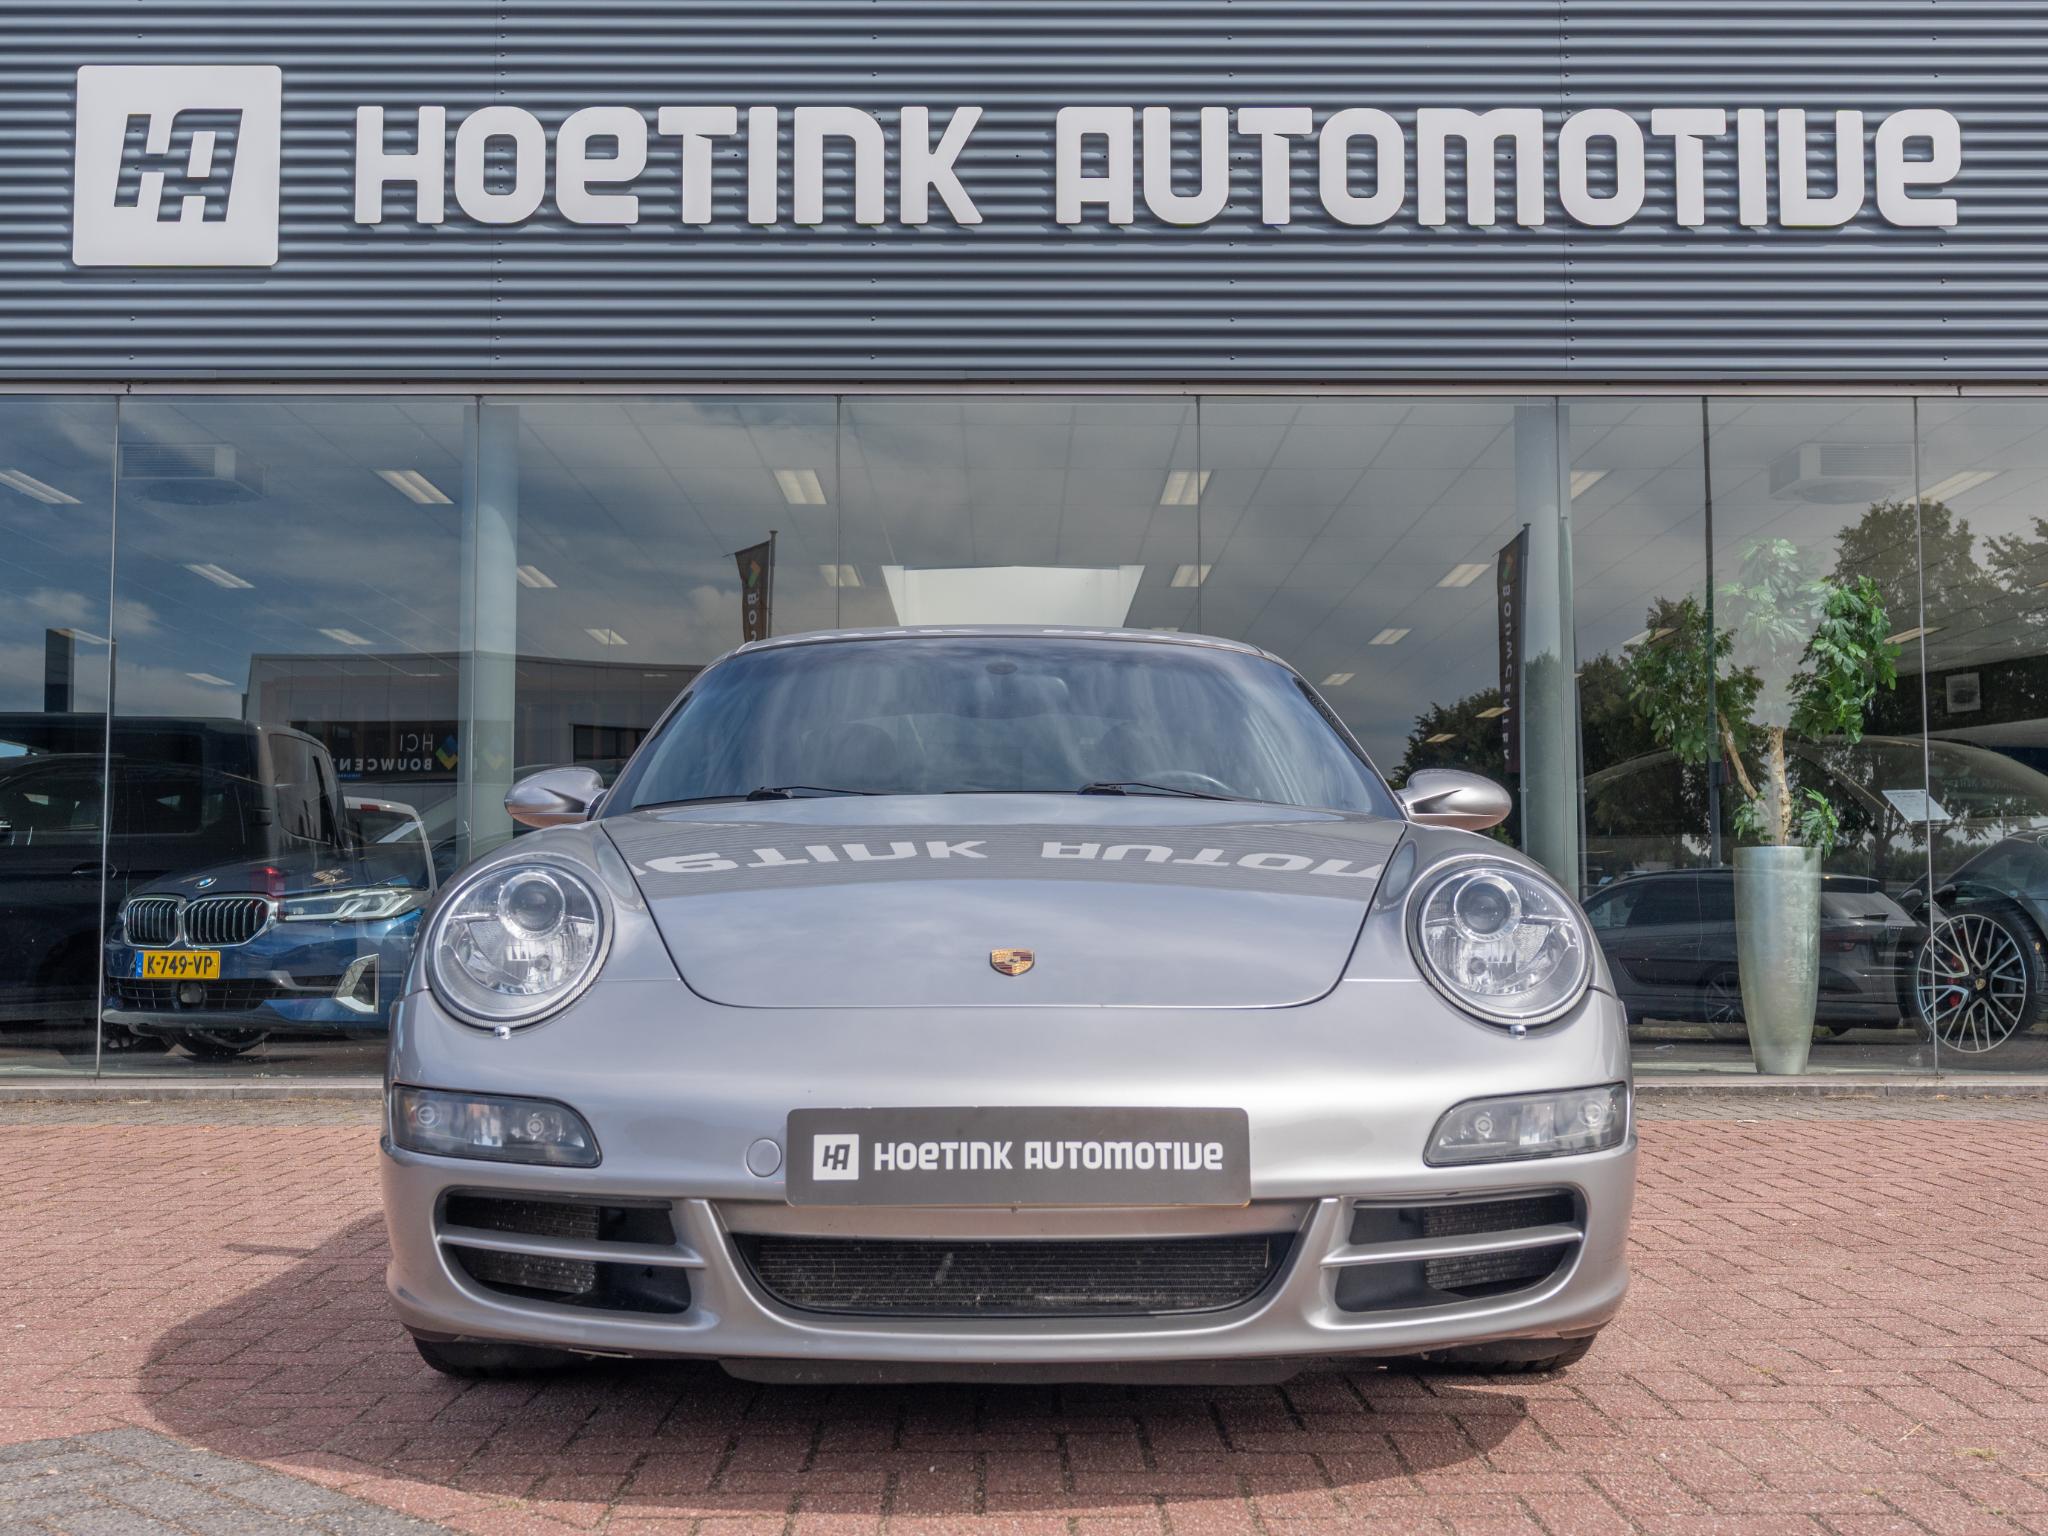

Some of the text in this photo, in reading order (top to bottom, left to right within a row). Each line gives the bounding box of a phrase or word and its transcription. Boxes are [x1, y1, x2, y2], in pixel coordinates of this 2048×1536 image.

[355, 105, 1962, 226] HOETINK AUTOMOTIVE
[146, 955, 213, 975] K-749-VP
[874, 1140, 1223, 1171] HOETINK AUTOMOTIVE
